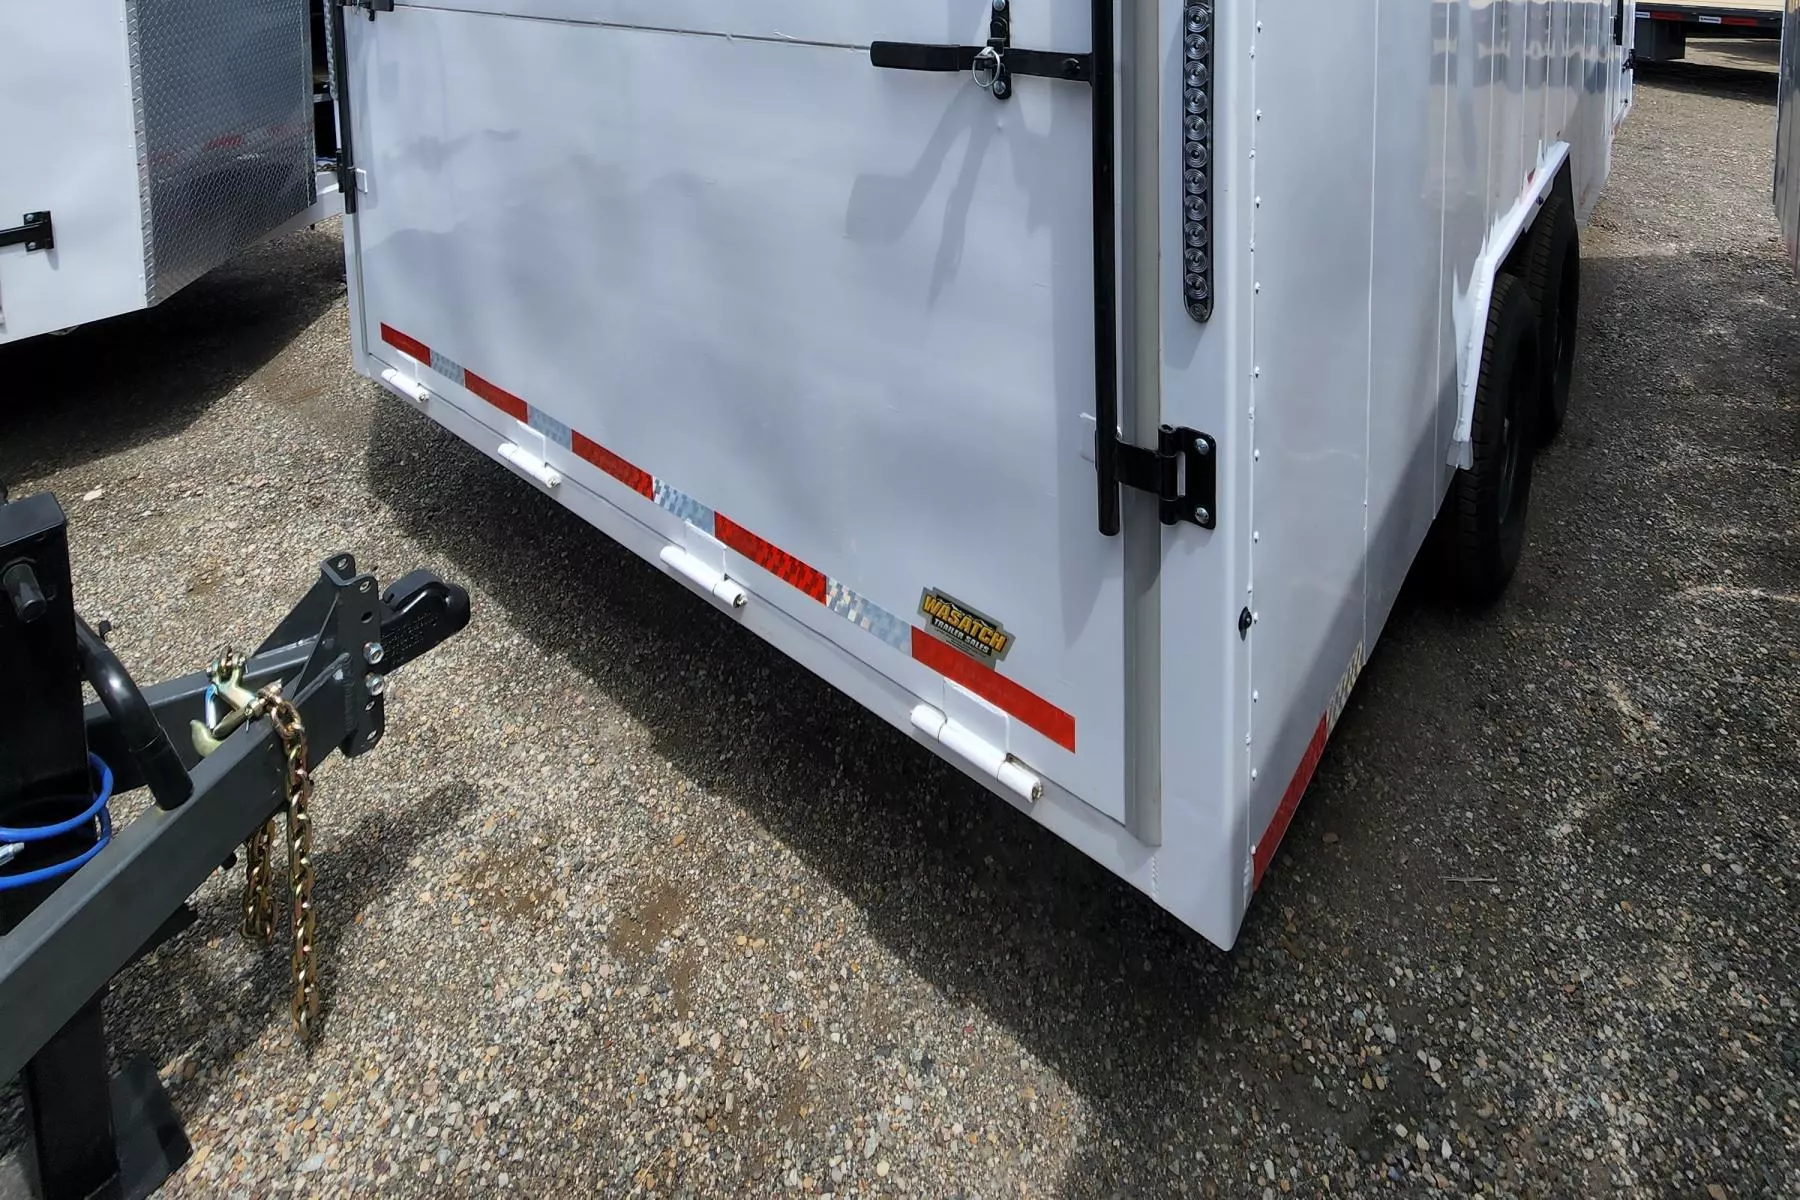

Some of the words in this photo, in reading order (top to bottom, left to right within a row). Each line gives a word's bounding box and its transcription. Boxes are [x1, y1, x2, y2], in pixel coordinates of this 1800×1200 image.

[923, 595, 1007, 652] WASATCH
[934, 618, 964, 639] TRAILER
[965, 636, 990, 653] SALES
